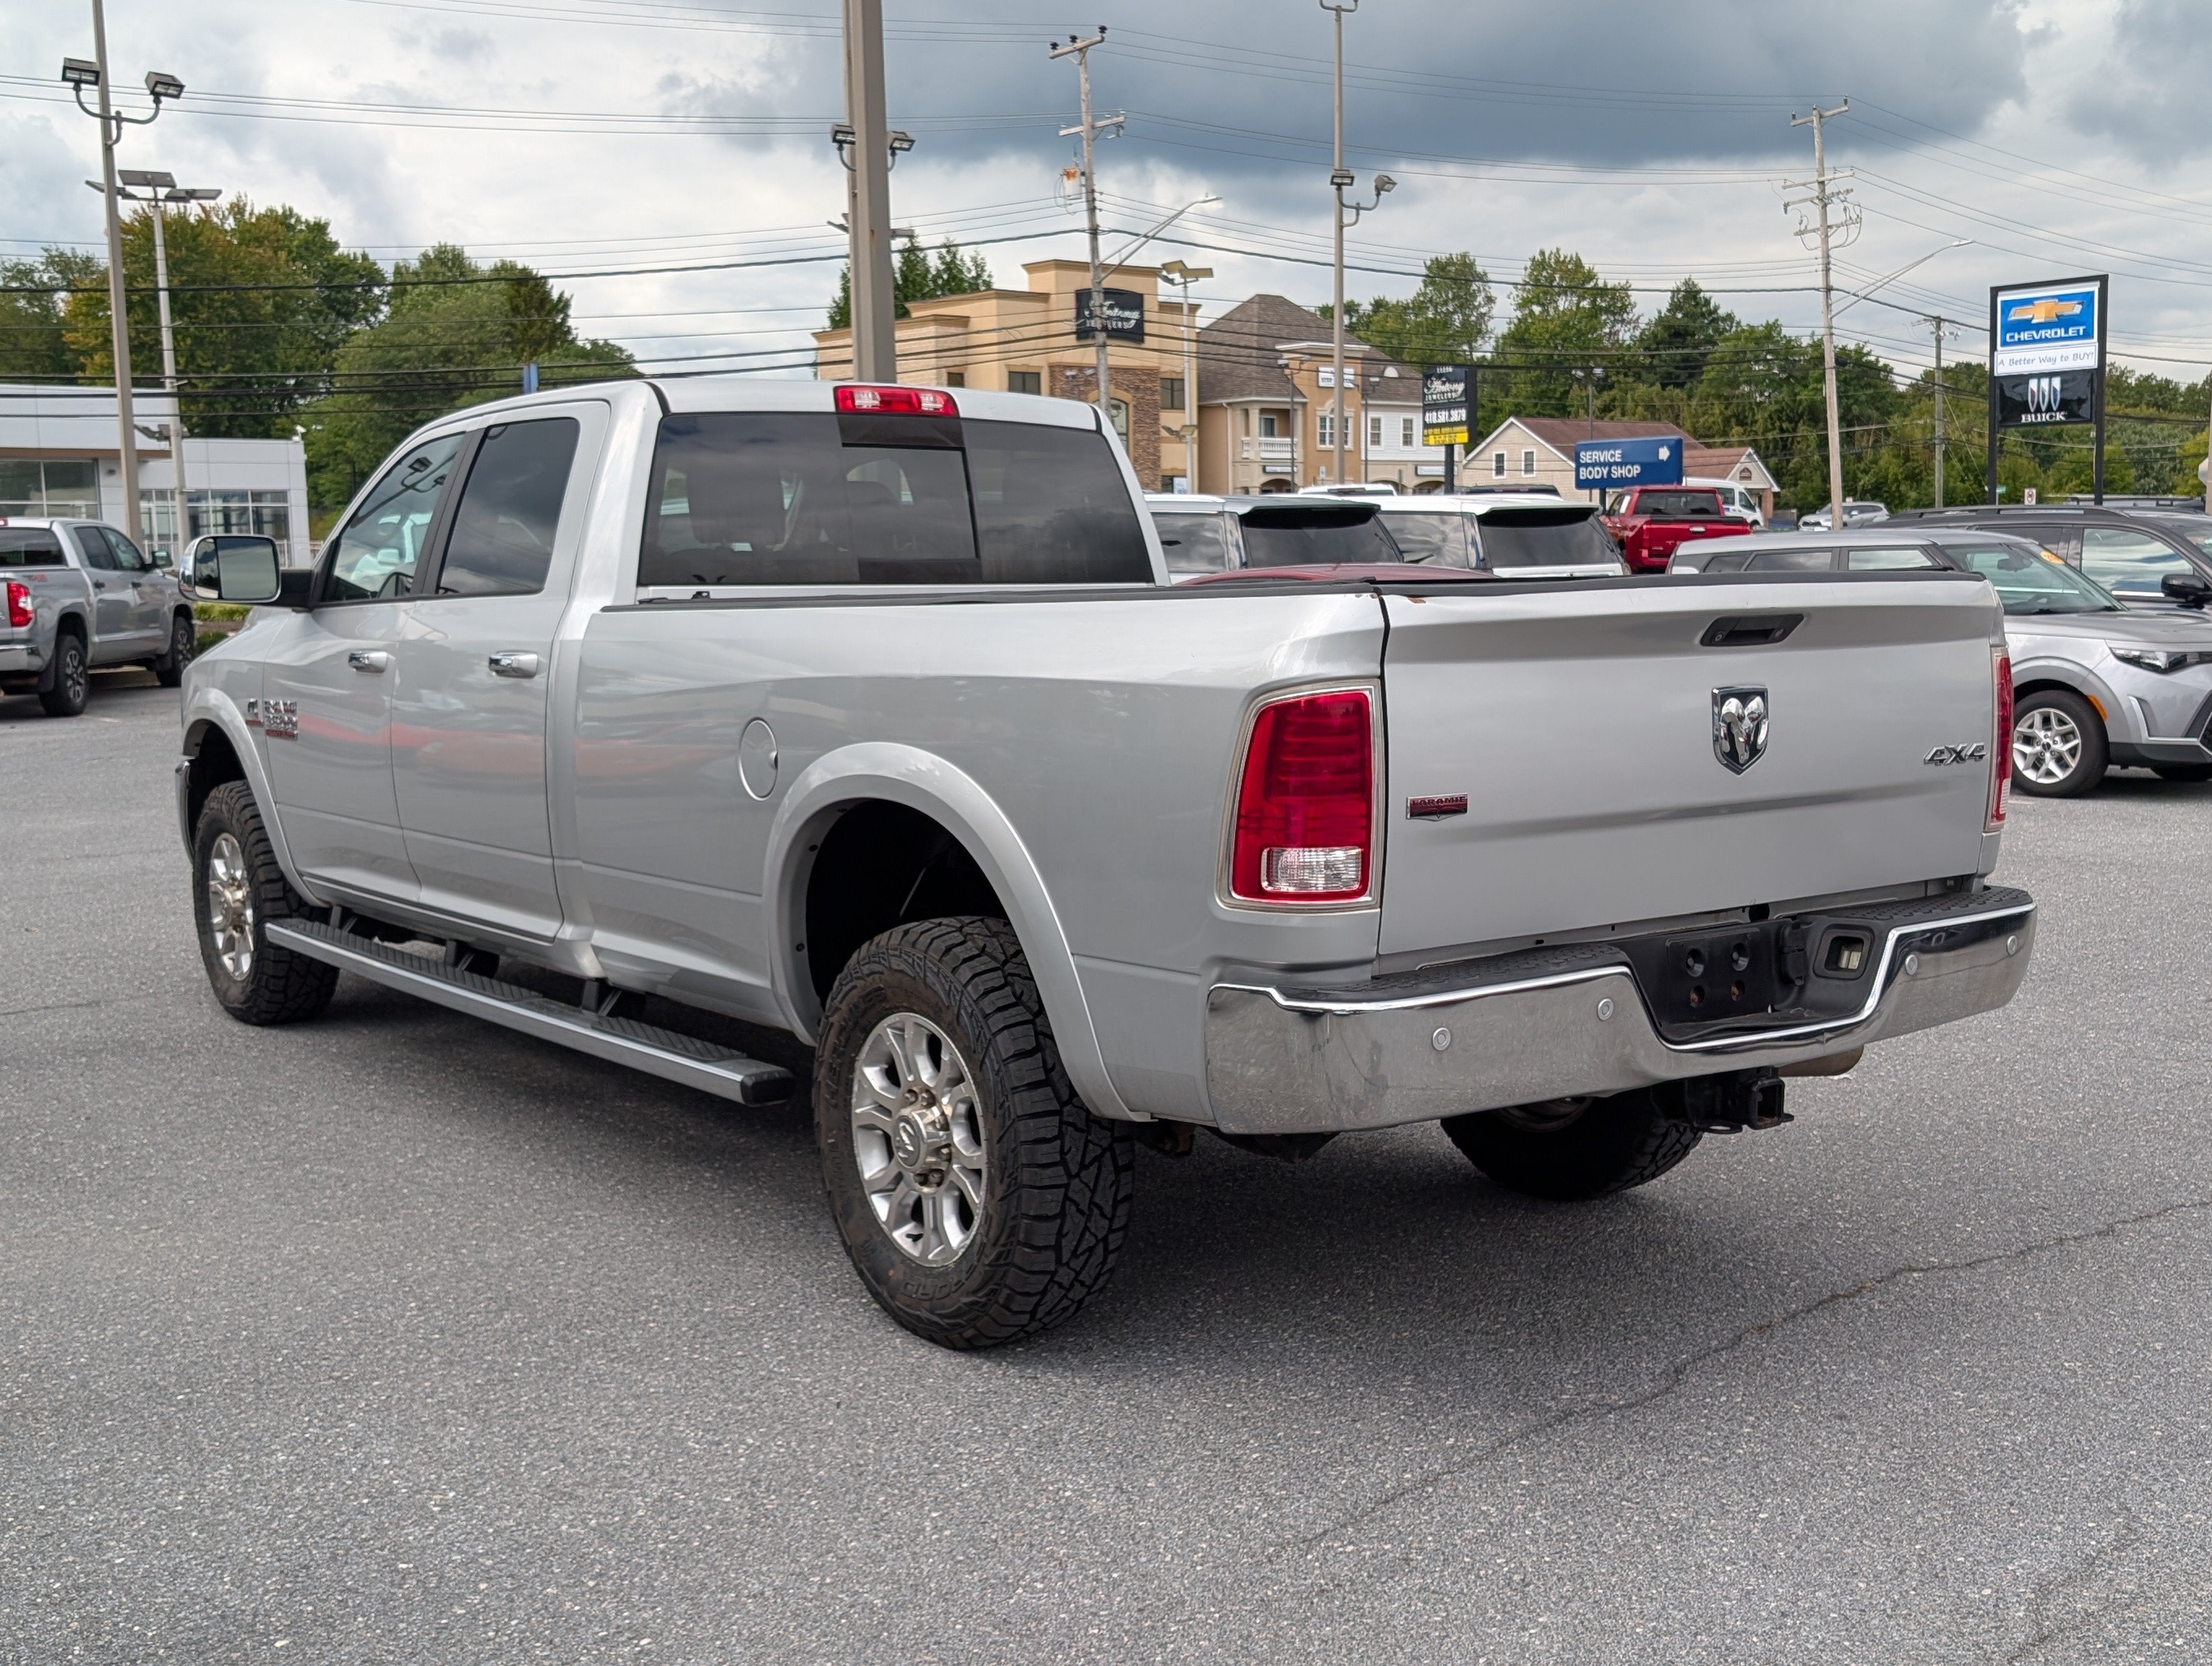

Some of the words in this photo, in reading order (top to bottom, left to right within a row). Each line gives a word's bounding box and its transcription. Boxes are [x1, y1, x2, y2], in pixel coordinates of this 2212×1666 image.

[2006, 325, 2086, 342] CHEVROLET
[1998, 358, 2005, 367] A
[2009, 357, 2036, 367] Better
[2039, 355, 2057, 365] Way
[2060, 353, 2069, 362] to
[2073, 351, 2094, 361] BUY!
[2021, 411, 2066, 423] BUICK
[1579, 448, 1623, 464] SERVICE
[1579, 465, 1609, 480] BODY
[1611, 464, 1641, 479] SHOP
[1924, 742, 1986, 766] 4X4
